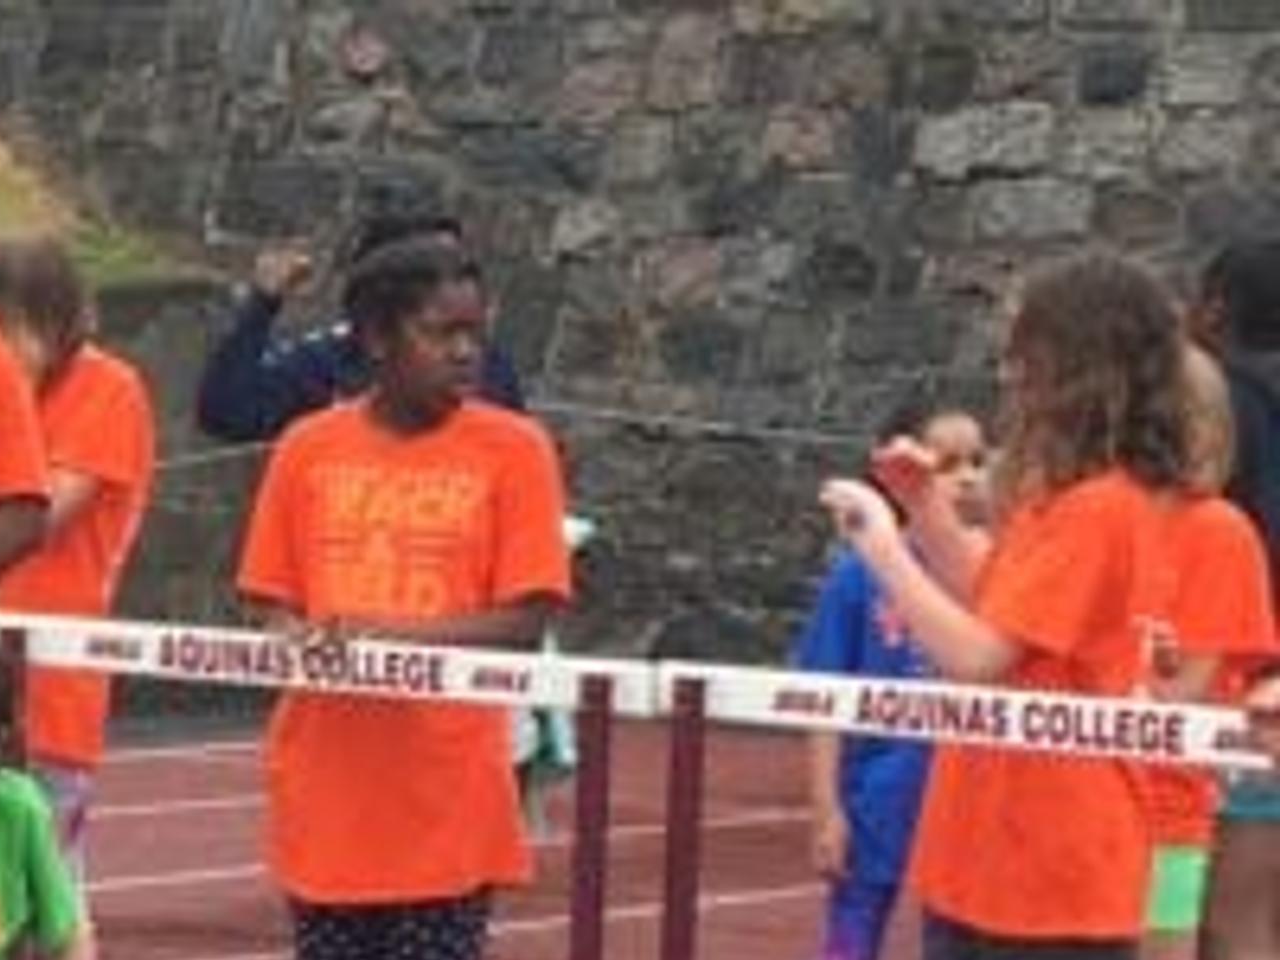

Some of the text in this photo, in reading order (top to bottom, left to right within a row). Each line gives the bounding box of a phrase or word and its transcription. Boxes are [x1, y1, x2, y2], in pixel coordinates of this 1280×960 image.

[159, 632, 294, 680] AQUINAS
[300, 642, 447, 692] COLLEGE
[855, 685, 1010, 738] AQUINAS
[1021, 703, 1188, 756] COLLEGE
